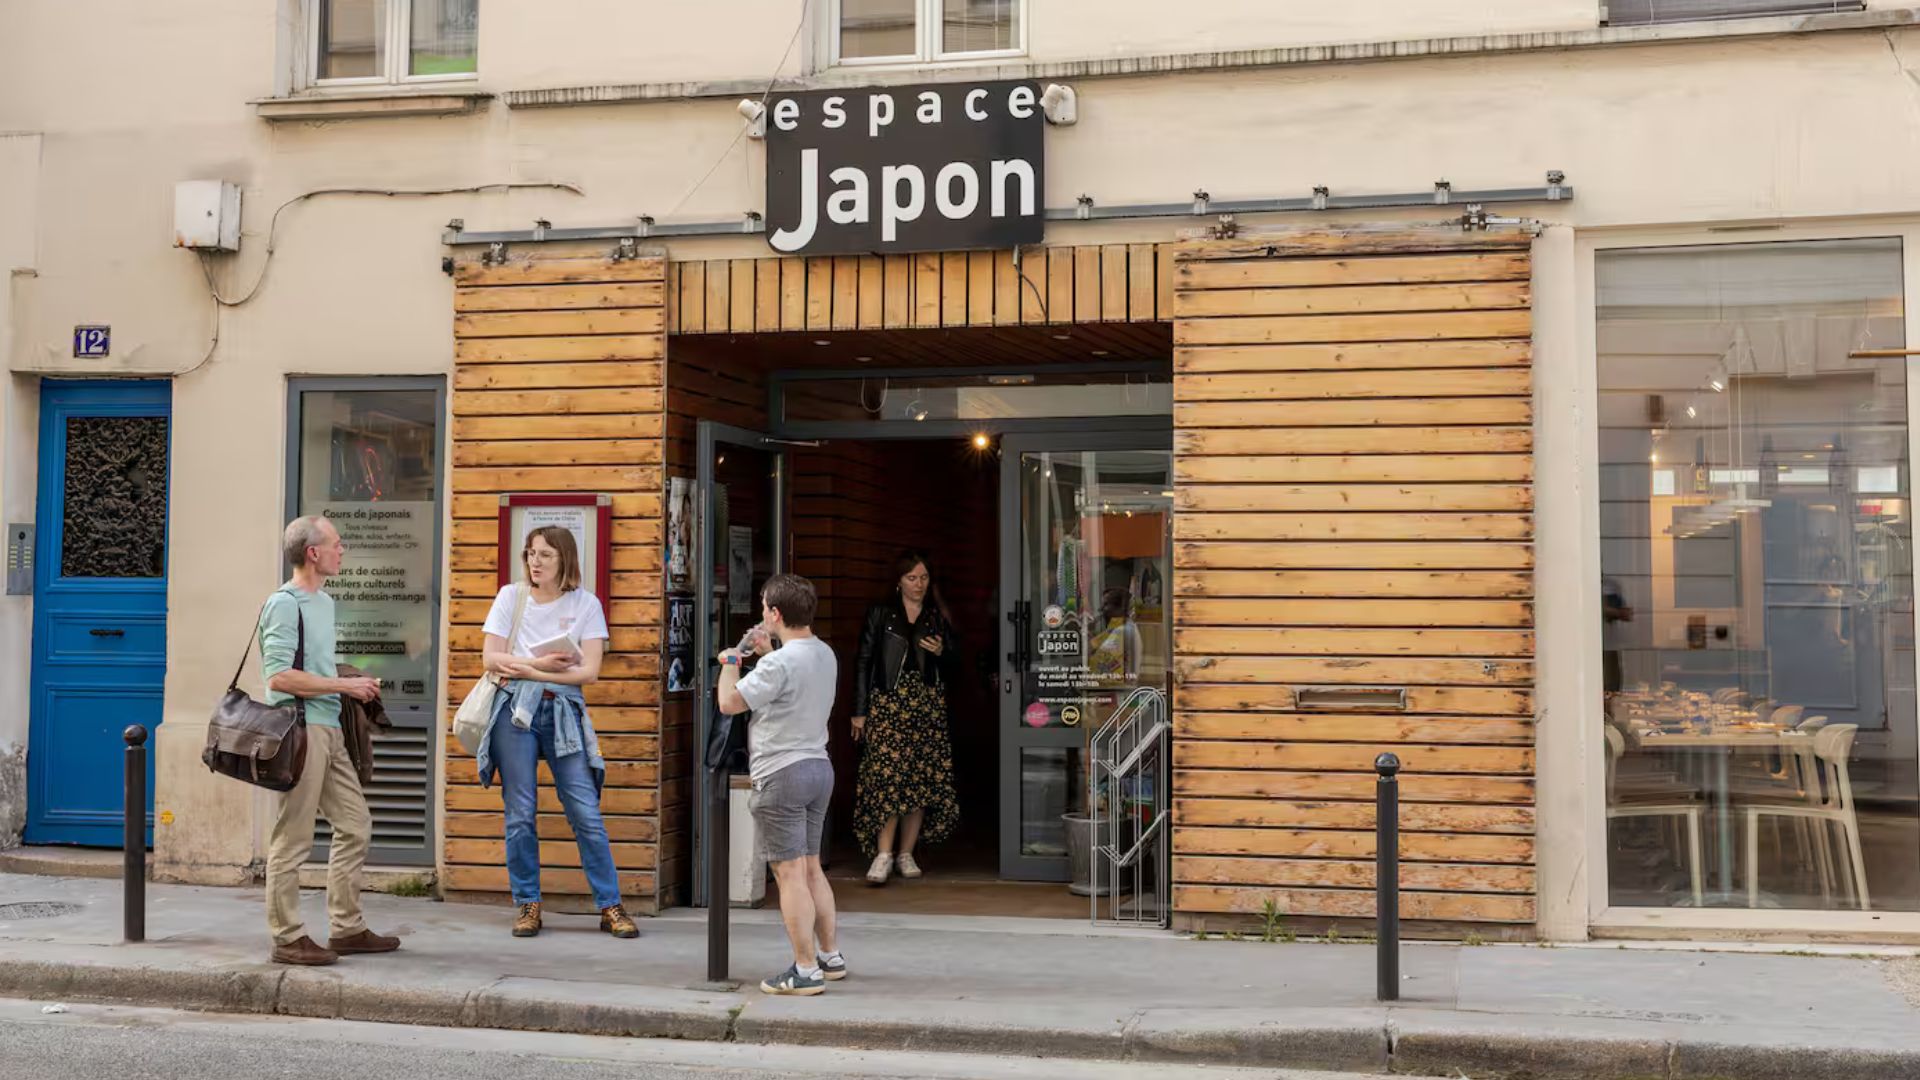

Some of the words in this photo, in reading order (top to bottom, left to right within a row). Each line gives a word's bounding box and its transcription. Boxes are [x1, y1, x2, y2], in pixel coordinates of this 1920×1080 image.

[773, 85, 1035, 137] espace
[769, 148, 1035, 251] Japon
[77, 330, 104, 353] 12
[323, 509, 351, 518] Cours
[353, 509, 366, 518] de
[368, 509, 411, 521] japonais
[338, 567, 353, 575] urs
[355, 566, 369, 575] de
[370, 566, 405, 575] cuisine
[323, 579, 361, 588] Ateliers
[363, 579, 406, 588] culturels
[342, 591, 355, 600] de
[357, 591, 426, 603] dessin-manga
[1039, 640, 1078, 653] Japon
